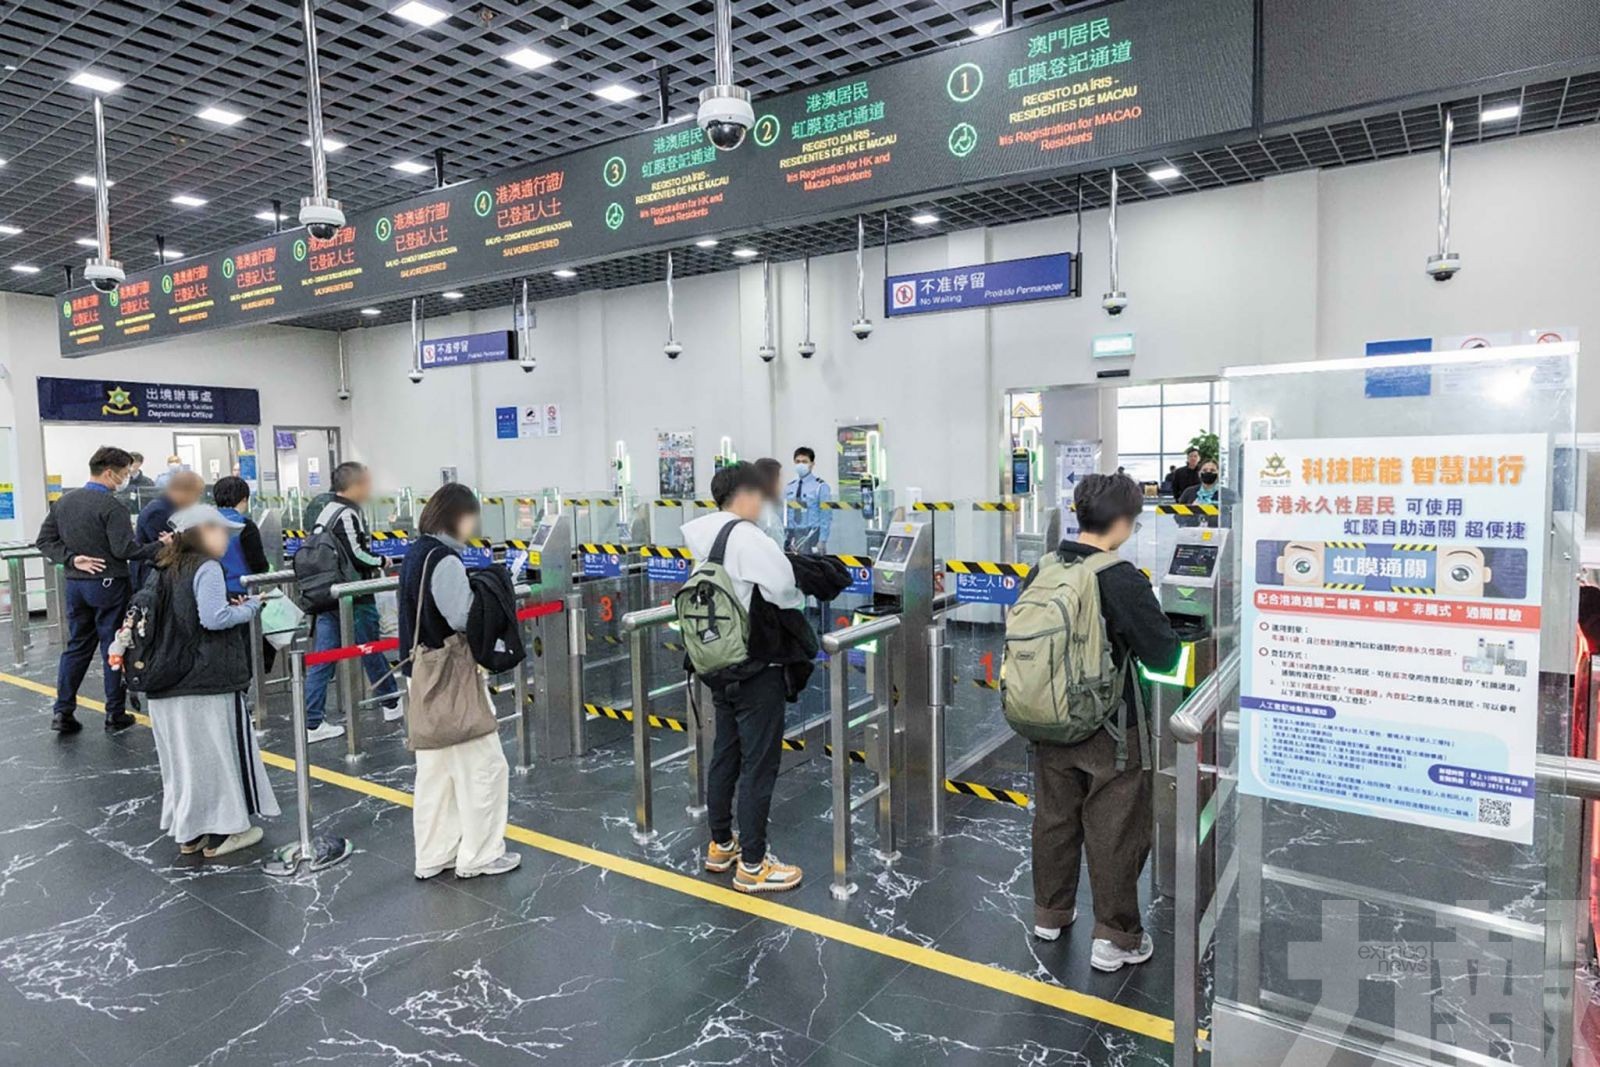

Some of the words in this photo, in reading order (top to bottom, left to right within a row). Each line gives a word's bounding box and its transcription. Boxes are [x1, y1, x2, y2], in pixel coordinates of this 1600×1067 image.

[1027, 17, 1110, 58] 澳門居民
[1008, 40, 1132, 89] 虹膜登記通道
[806, 81, 868, 113] 港澳居民
[1009, 100, 1077, 123] RESIDENTES
[1079, 96, 1095, 108] DE
[1097, 86, 1138, 104] MACAU
[1022, 87, 1070, 107] REGISTO
[1072, 83, 1089, 94] DA
[791, 101, 885, 139] 虹膜登記通道
[1015, 121, 1077, 143] Registration
[1078, 118, 1093, 129] for
[1095, 106, 1142, 126] MACAO
[652, 128, 703, 154] 港澳居民
[802, 137, 839, 153] REGISTO
[840, 134, 853, 145] DA
[1041, 132, 1093, 150] Residents
[779, 149, 831, 168] RESIDENTES
[831, 146, 844, 157] DE
[495, 171, 564, 205] 港澳通行證/
[497, 197, 561, 229] 已登記人士
[395, 225, 449, 253] 已登記人士
[920, 271, 985, 295] 不准停留
[920, 297, 931, 306] No
[932, 293, 962, 305] Waiting
[145, 387, 213, 403] 出境辦事處
[147, 410, 190, 418] Departures
[191, 411, 214, 419] Office
[1302, 455, 1404, 485] 科技賦能
[1411, 454, 1526, 485] 智慧出行
[1257, 496, 1395, 515] 香港永久性居民
[1405, 498, 1463, 516] 可使用
[1344, 519, 1457, 538] 虹膜自助通關
[1465, 521, 1526, 540] 超便捷
[1333, 555, 1428, 578] 虹膜通關
[600, 595, 613, 622] 3
[979, 651, 993, 685] 1
